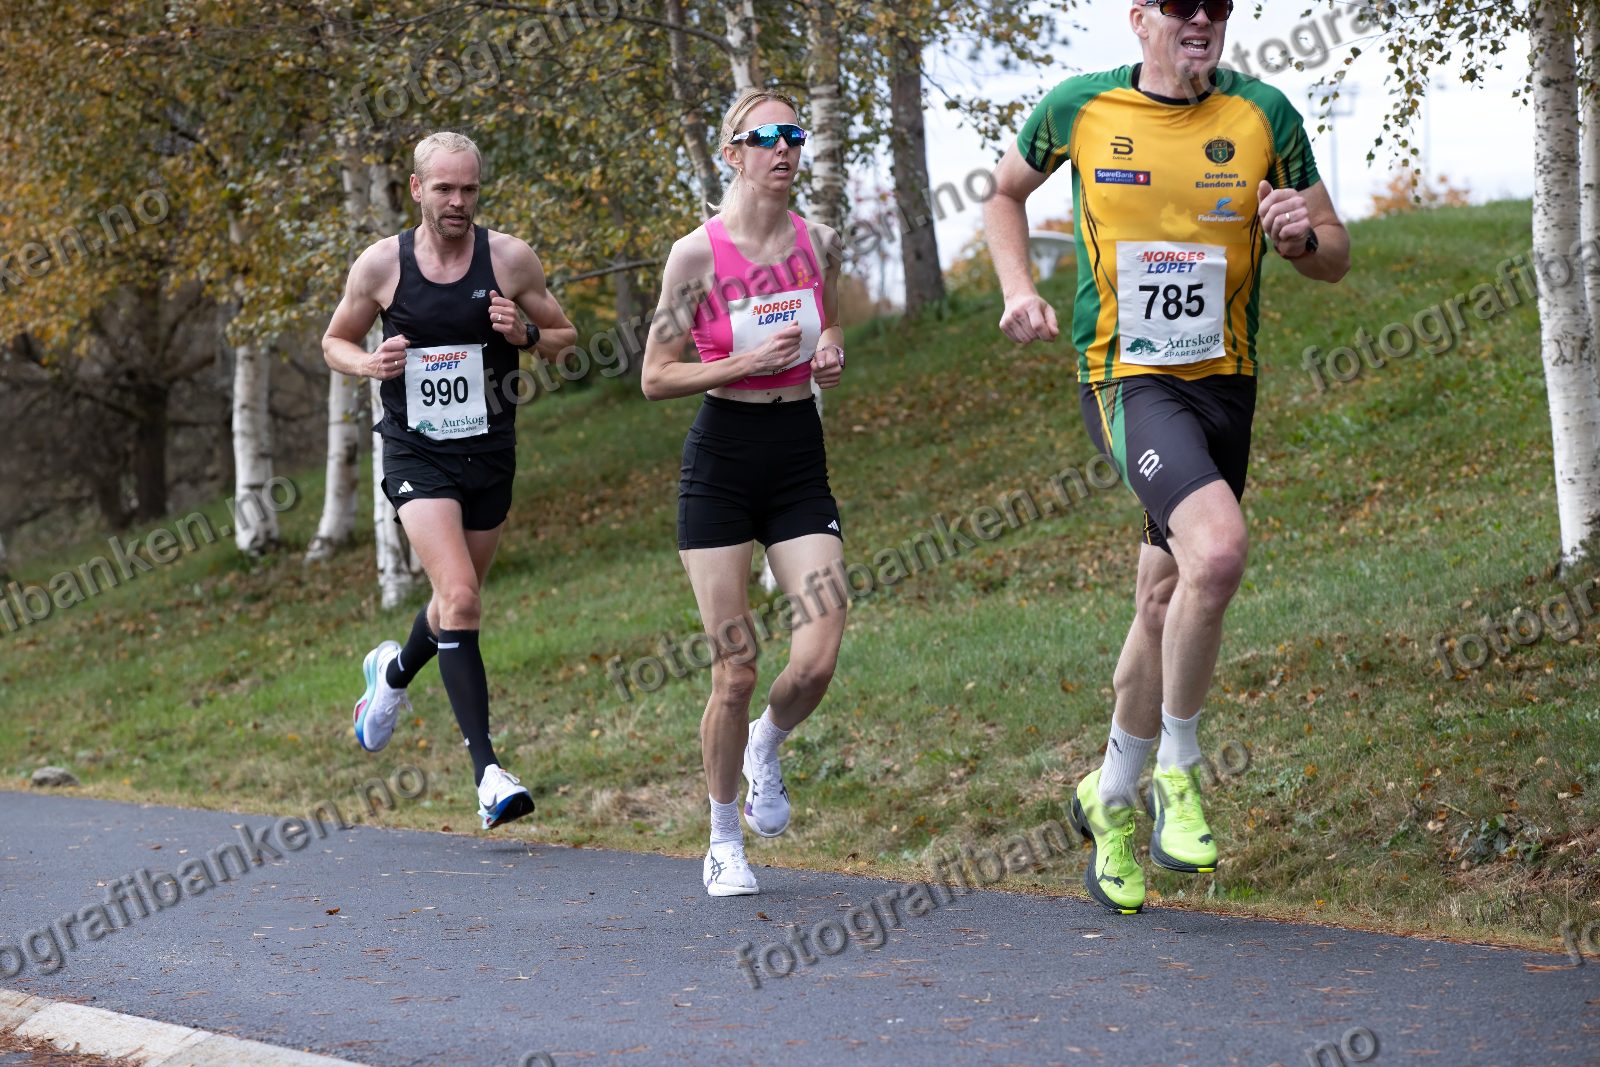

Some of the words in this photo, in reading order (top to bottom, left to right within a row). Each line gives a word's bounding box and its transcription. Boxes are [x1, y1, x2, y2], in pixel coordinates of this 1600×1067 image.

[1205, 172, 1239, 180] Grefsen
[1139, 250, 1205, 262] NORGES
[1147, 262, 1196, 274] LØPET
[754, 299, 801, 314] NORGES
[1139, 283, 1205, 320] 785
[758, 310, 796, 325] LØPET
[1165, 333, 1220, 349] Aurskog
[421, 351, 467, 363] NORGES
[1164, 346, 1212, 357] SPAREBANK
[425, 361, 460, 371] LØPET
[420, 376, 468, 406] 990
[441, 416, 485, 428] Aurskog
